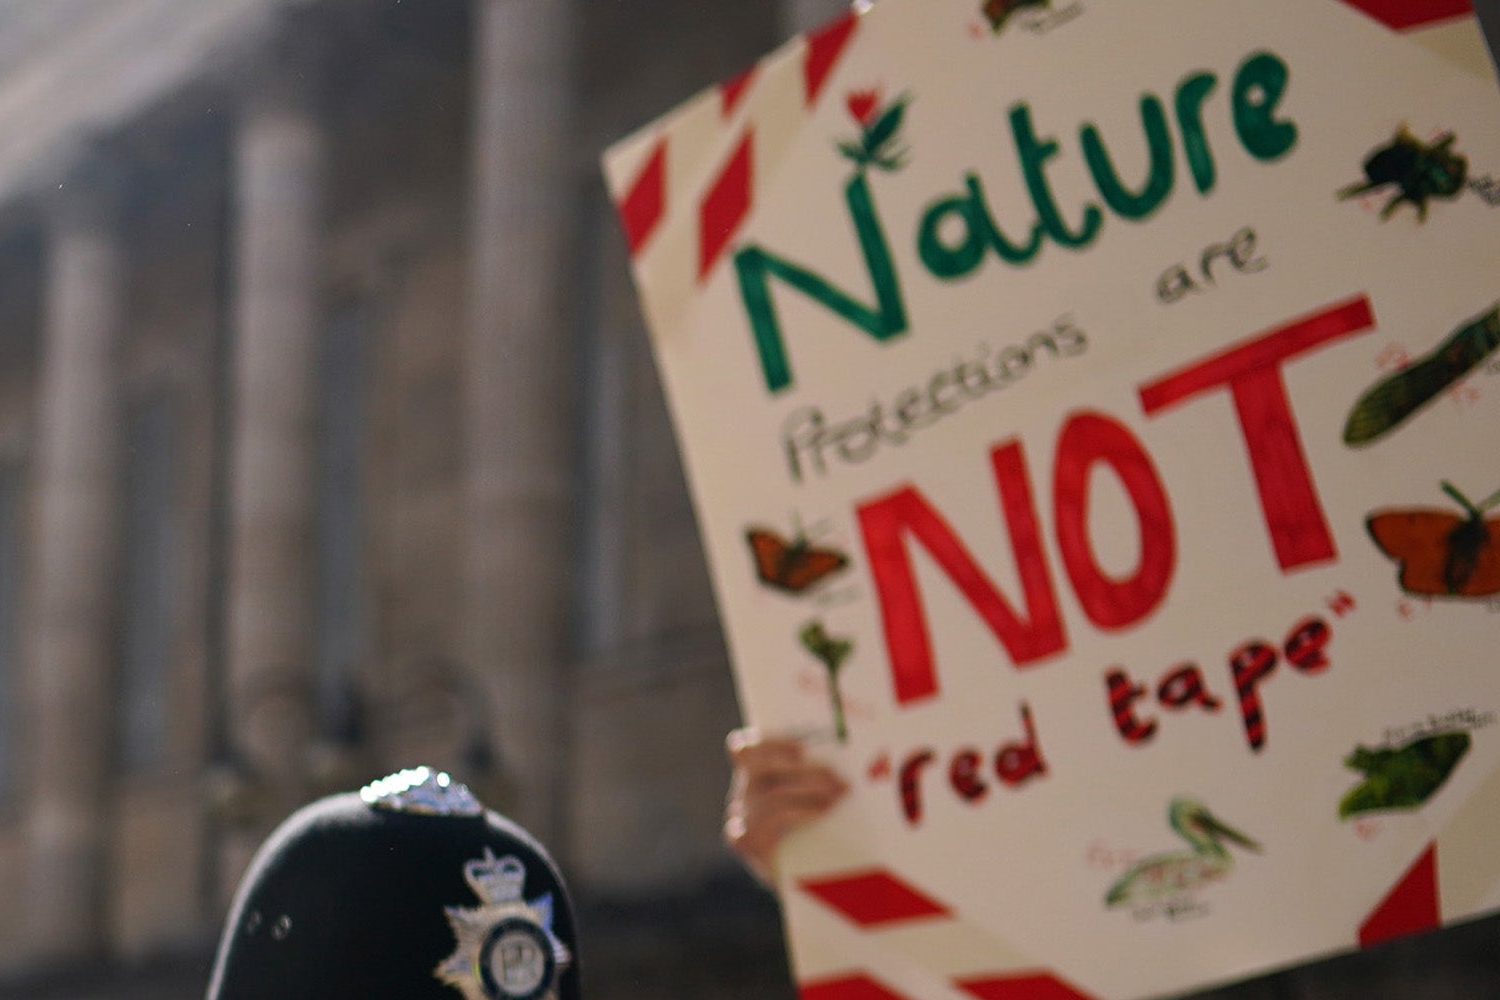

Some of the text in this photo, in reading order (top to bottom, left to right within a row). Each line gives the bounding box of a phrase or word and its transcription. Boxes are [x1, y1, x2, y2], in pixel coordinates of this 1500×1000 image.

[732, 50, 1298, 393] Nature
[780, 226, 1270, 484] Protections are
[857, 294, 1377, 705] NOT
